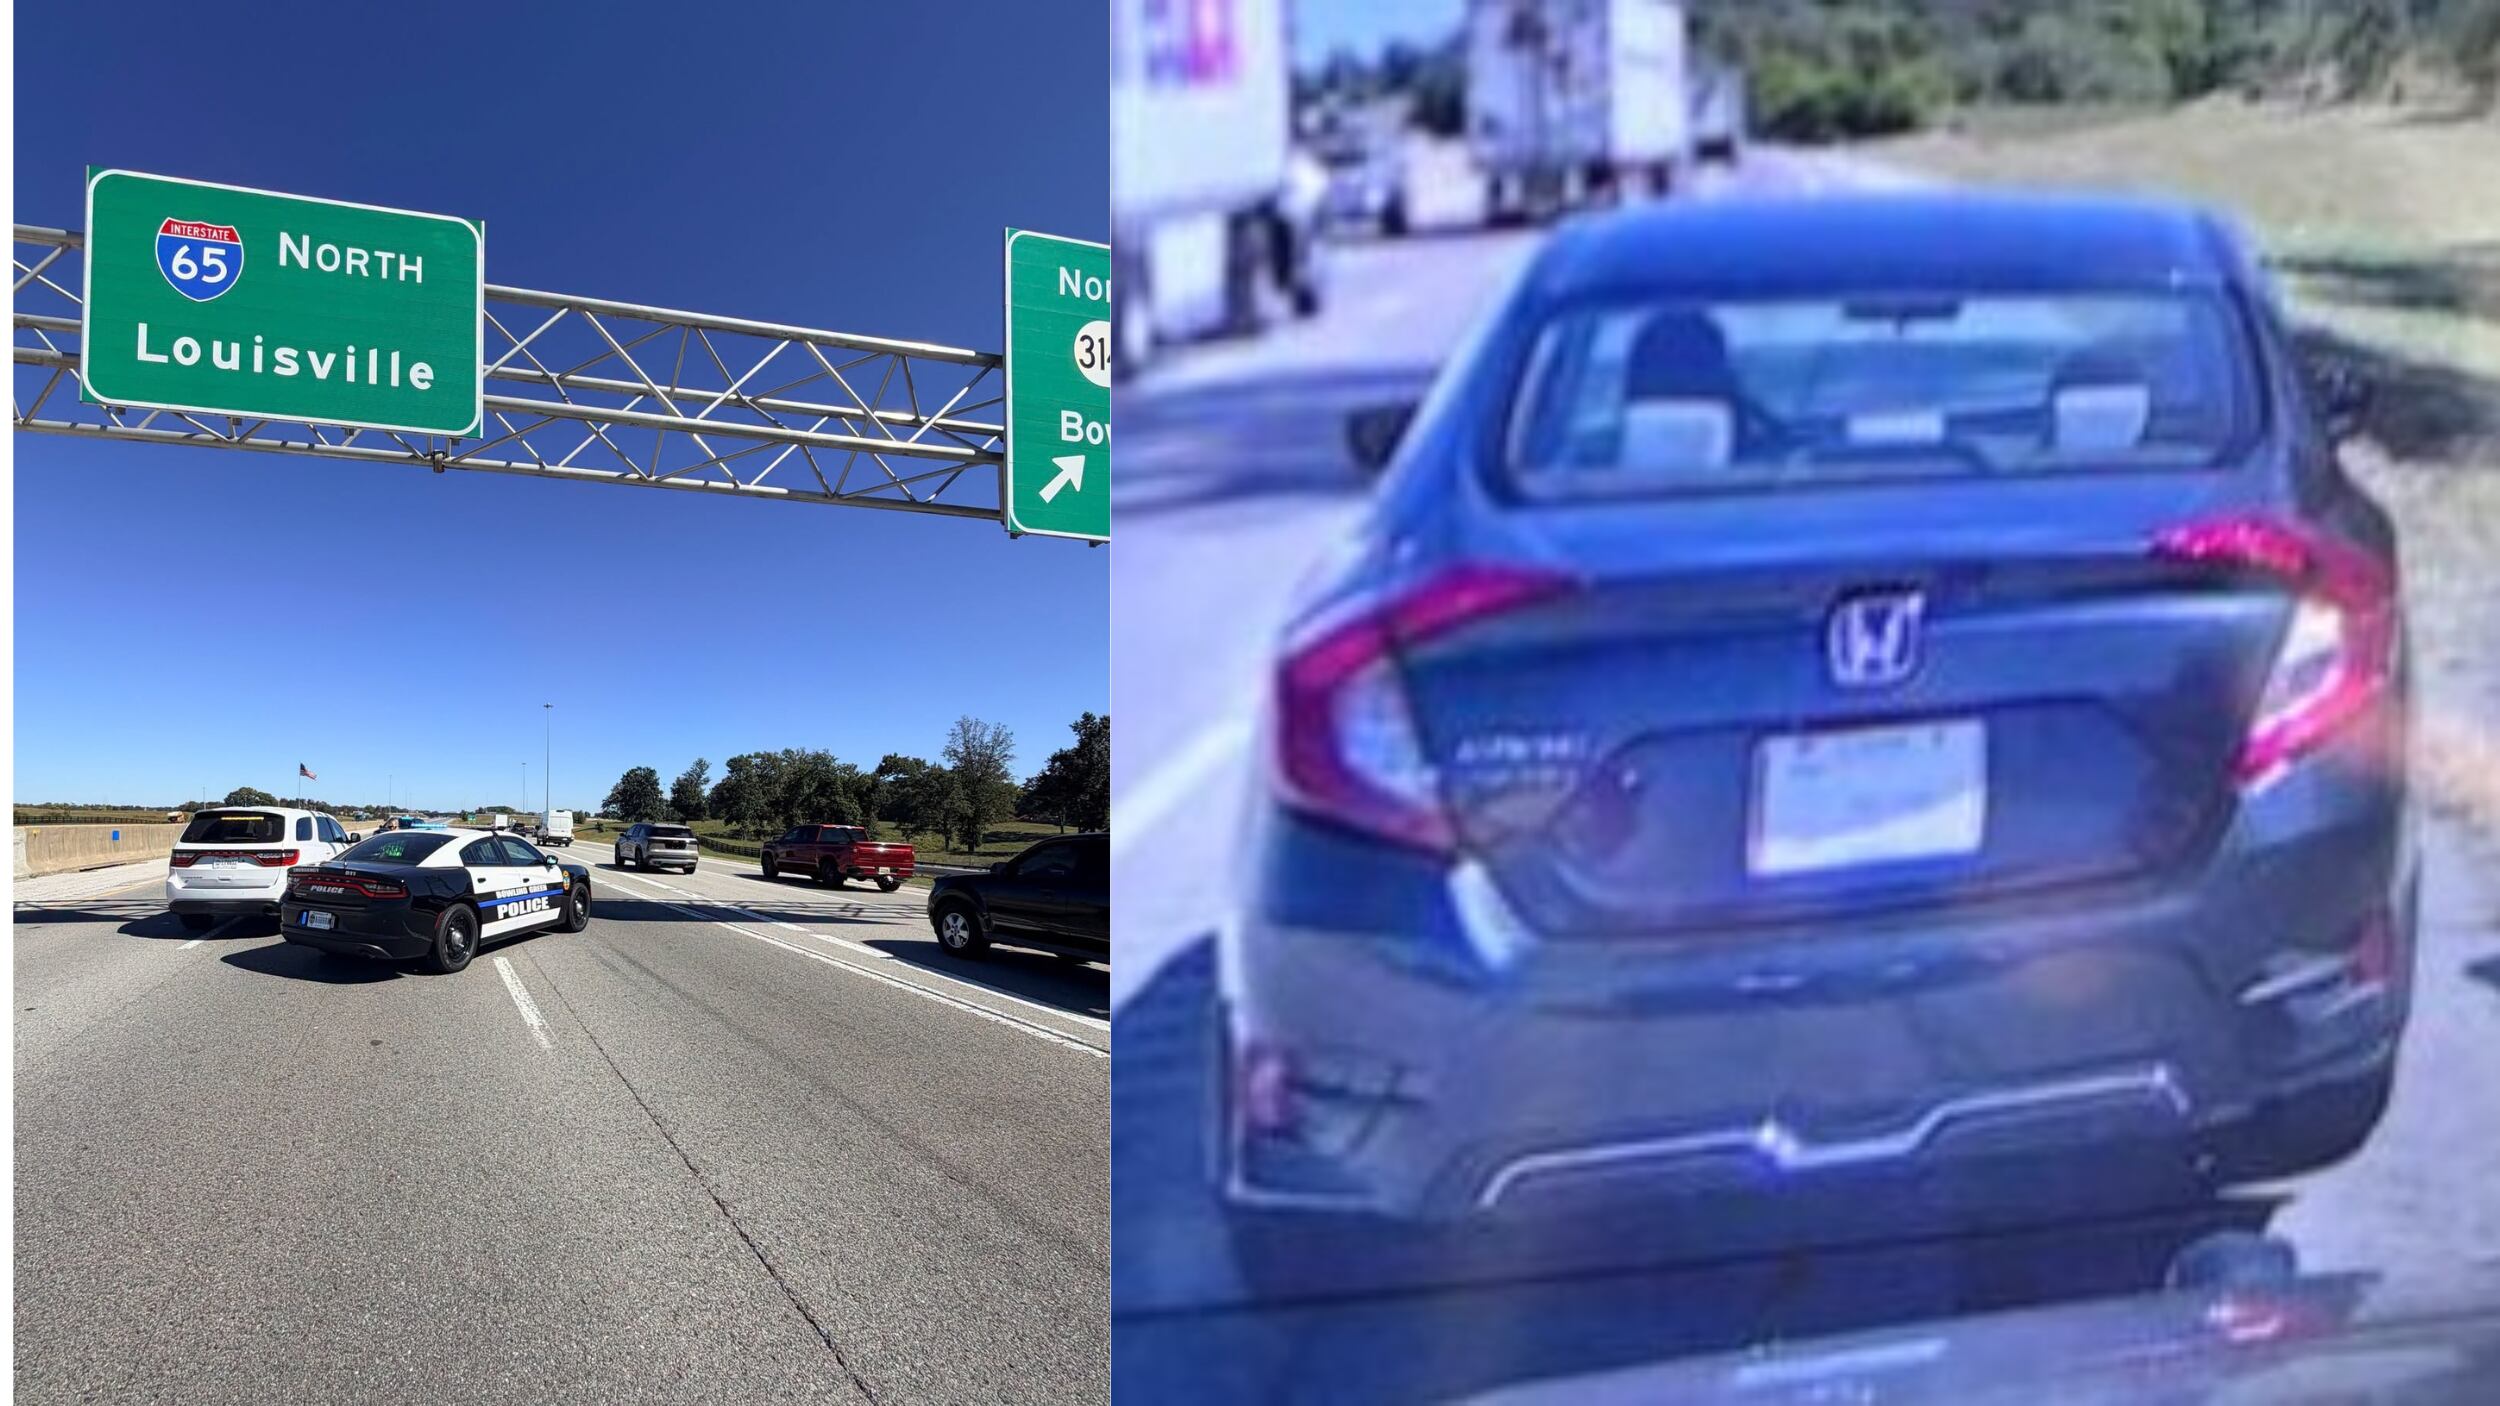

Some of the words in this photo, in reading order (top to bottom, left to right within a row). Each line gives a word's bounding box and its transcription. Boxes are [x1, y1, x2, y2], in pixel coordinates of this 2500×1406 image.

[170, 223, 230, 241] INTERSTATE
[171, 244, 228, 284] 65
[278, 231, 424, 284] NORTH
[137, 322, 435, 390] Louisville
[1079, 334, 1110, 371] 31
[311, 885, 345, 894] POLICE
[497, 896, 550, 920] POLICE
